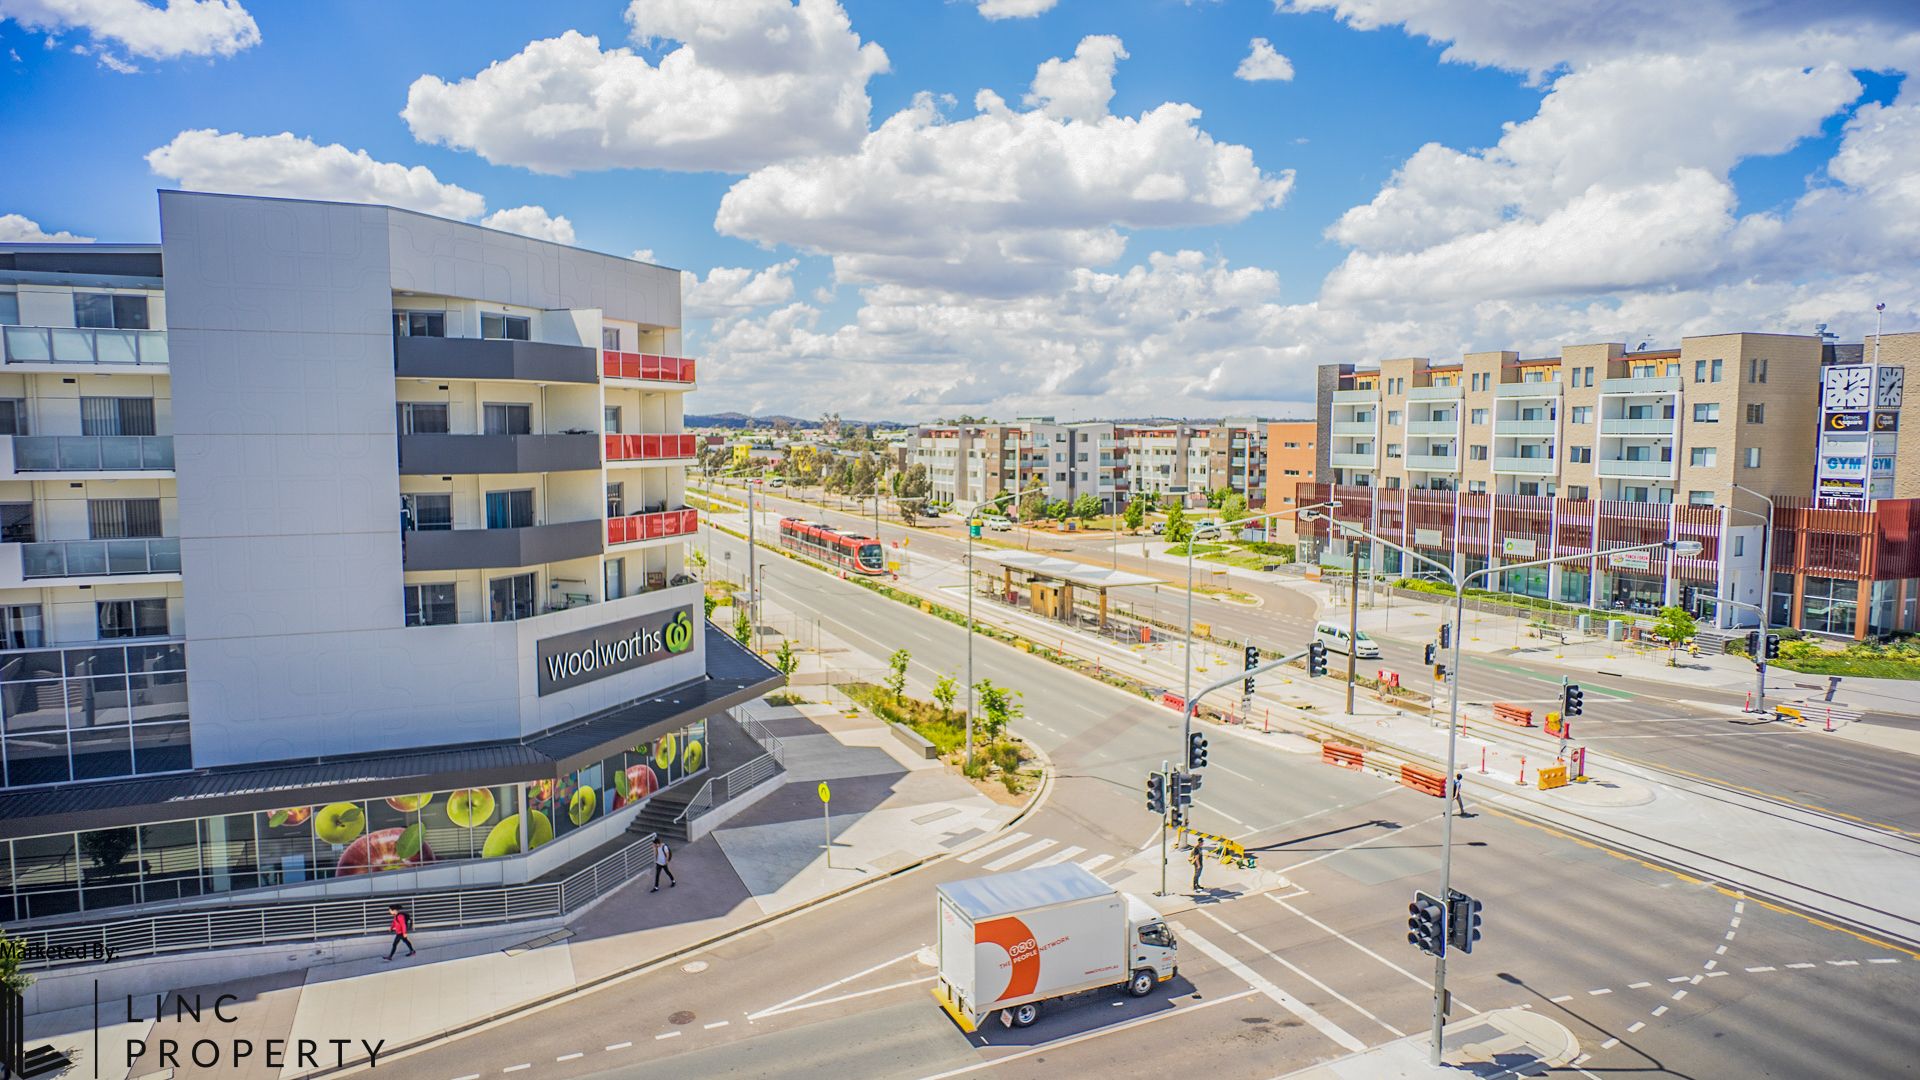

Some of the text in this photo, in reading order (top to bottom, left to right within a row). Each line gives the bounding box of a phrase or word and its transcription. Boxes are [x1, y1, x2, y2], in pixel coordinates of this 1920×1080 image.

[1827, 457, 1862, 470] GYM
[1872, 458, 1892, 470] GYM
[547, 627, 662, 682] Woolworths
[999, 935, 1070, 970] THE PEOPLE NETWORK
[1009, 938, 1036, 957] TNT
